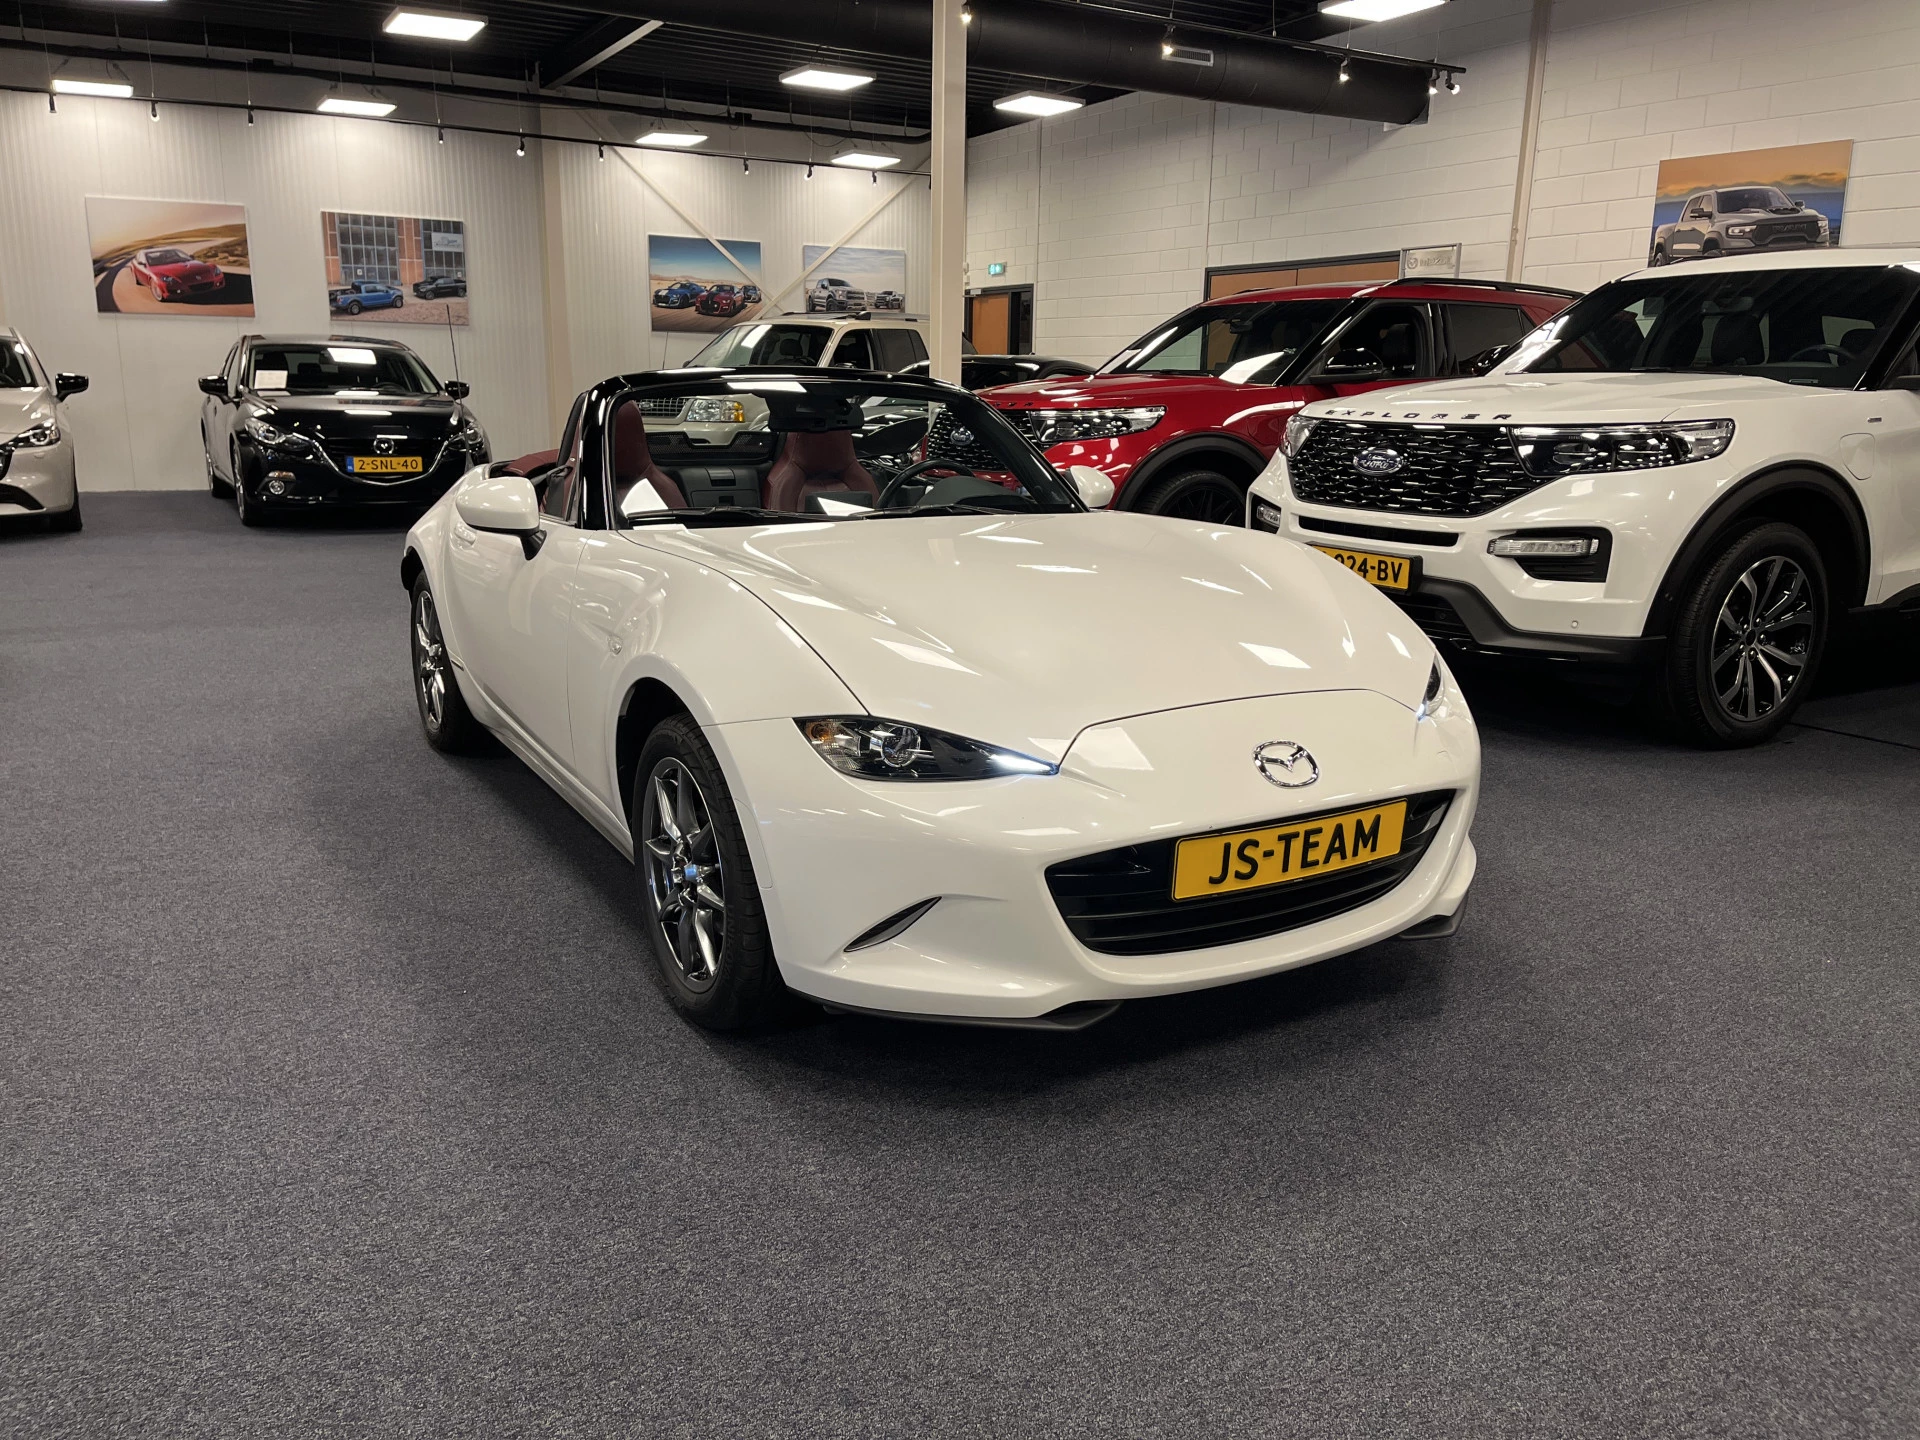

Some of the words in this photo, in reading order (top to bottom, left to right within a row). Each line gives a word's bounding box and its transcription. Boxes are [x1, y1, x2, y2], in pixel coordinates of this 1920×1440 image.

[1324, 409, 1512, 420] EXPLORER
[358, 459, 418, 470] 2-SNL-40
[1208, 814, 1382, 885] JS-TEAM
